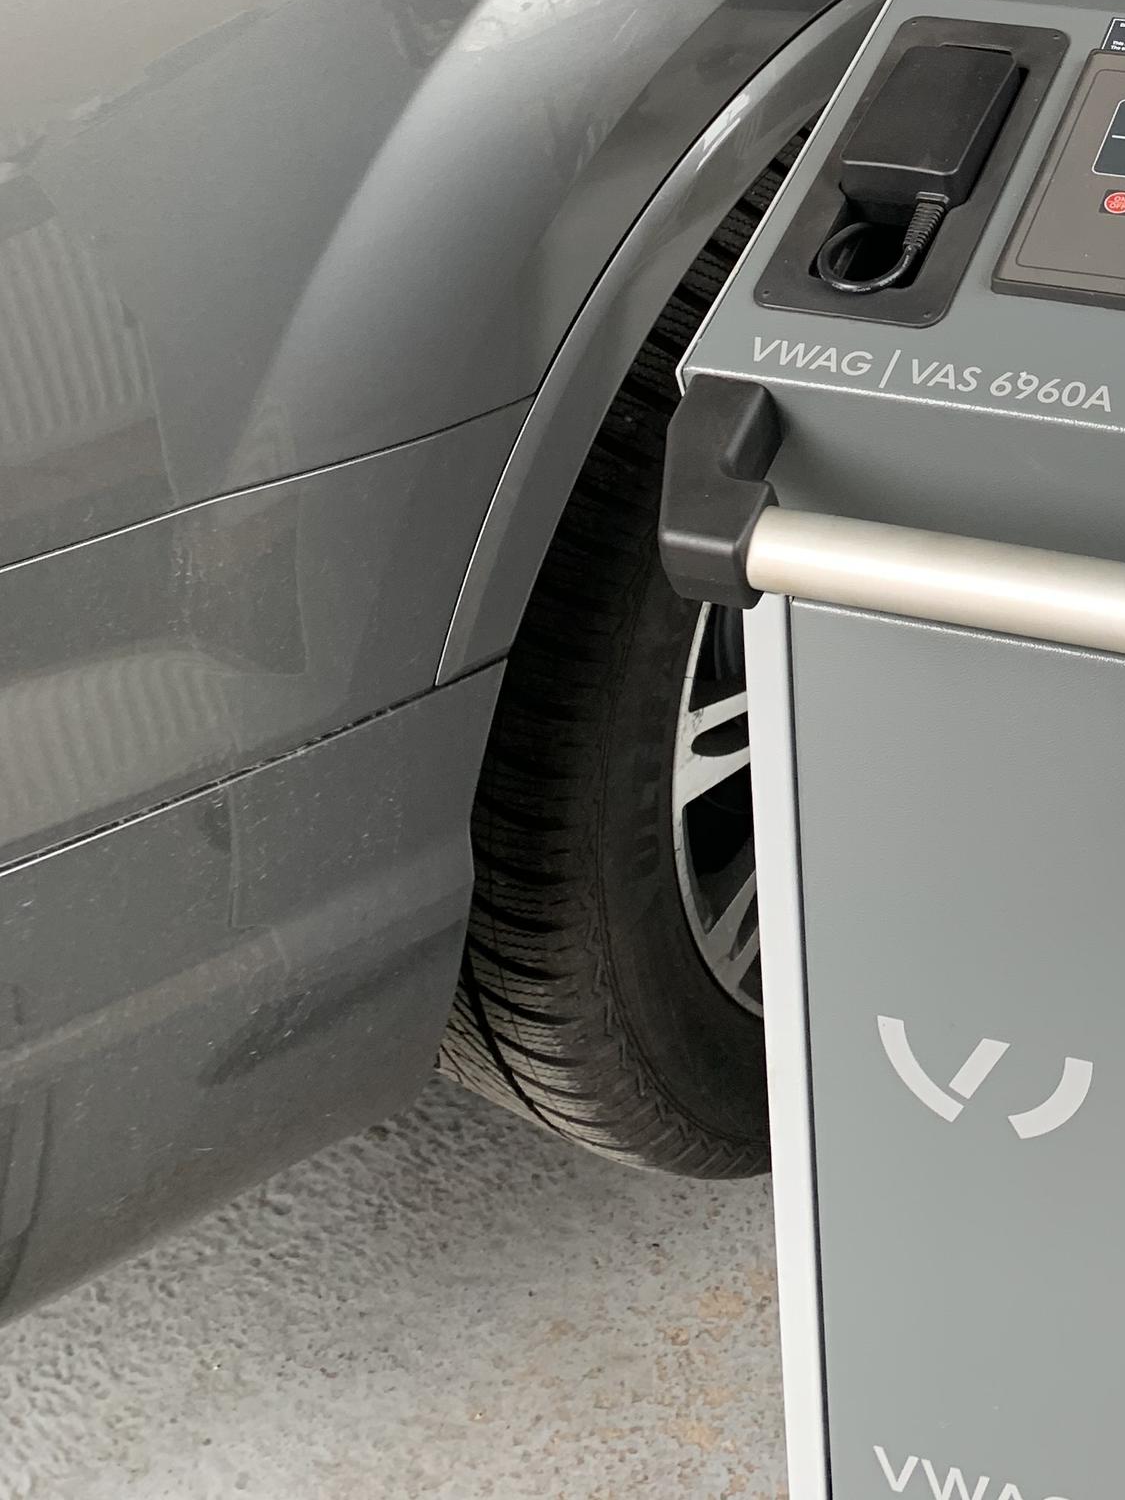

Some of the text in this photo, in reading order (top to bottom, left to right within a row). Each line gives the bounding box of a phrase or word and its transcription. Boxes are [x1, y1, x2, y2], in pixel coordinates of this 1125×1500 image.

[752, 336, 872, 377] VWAG
[911, 358, 983, 393] VAS
[990, 372, 1113, 413] 6960A
[873, 1445, 1070, 1500] VW
